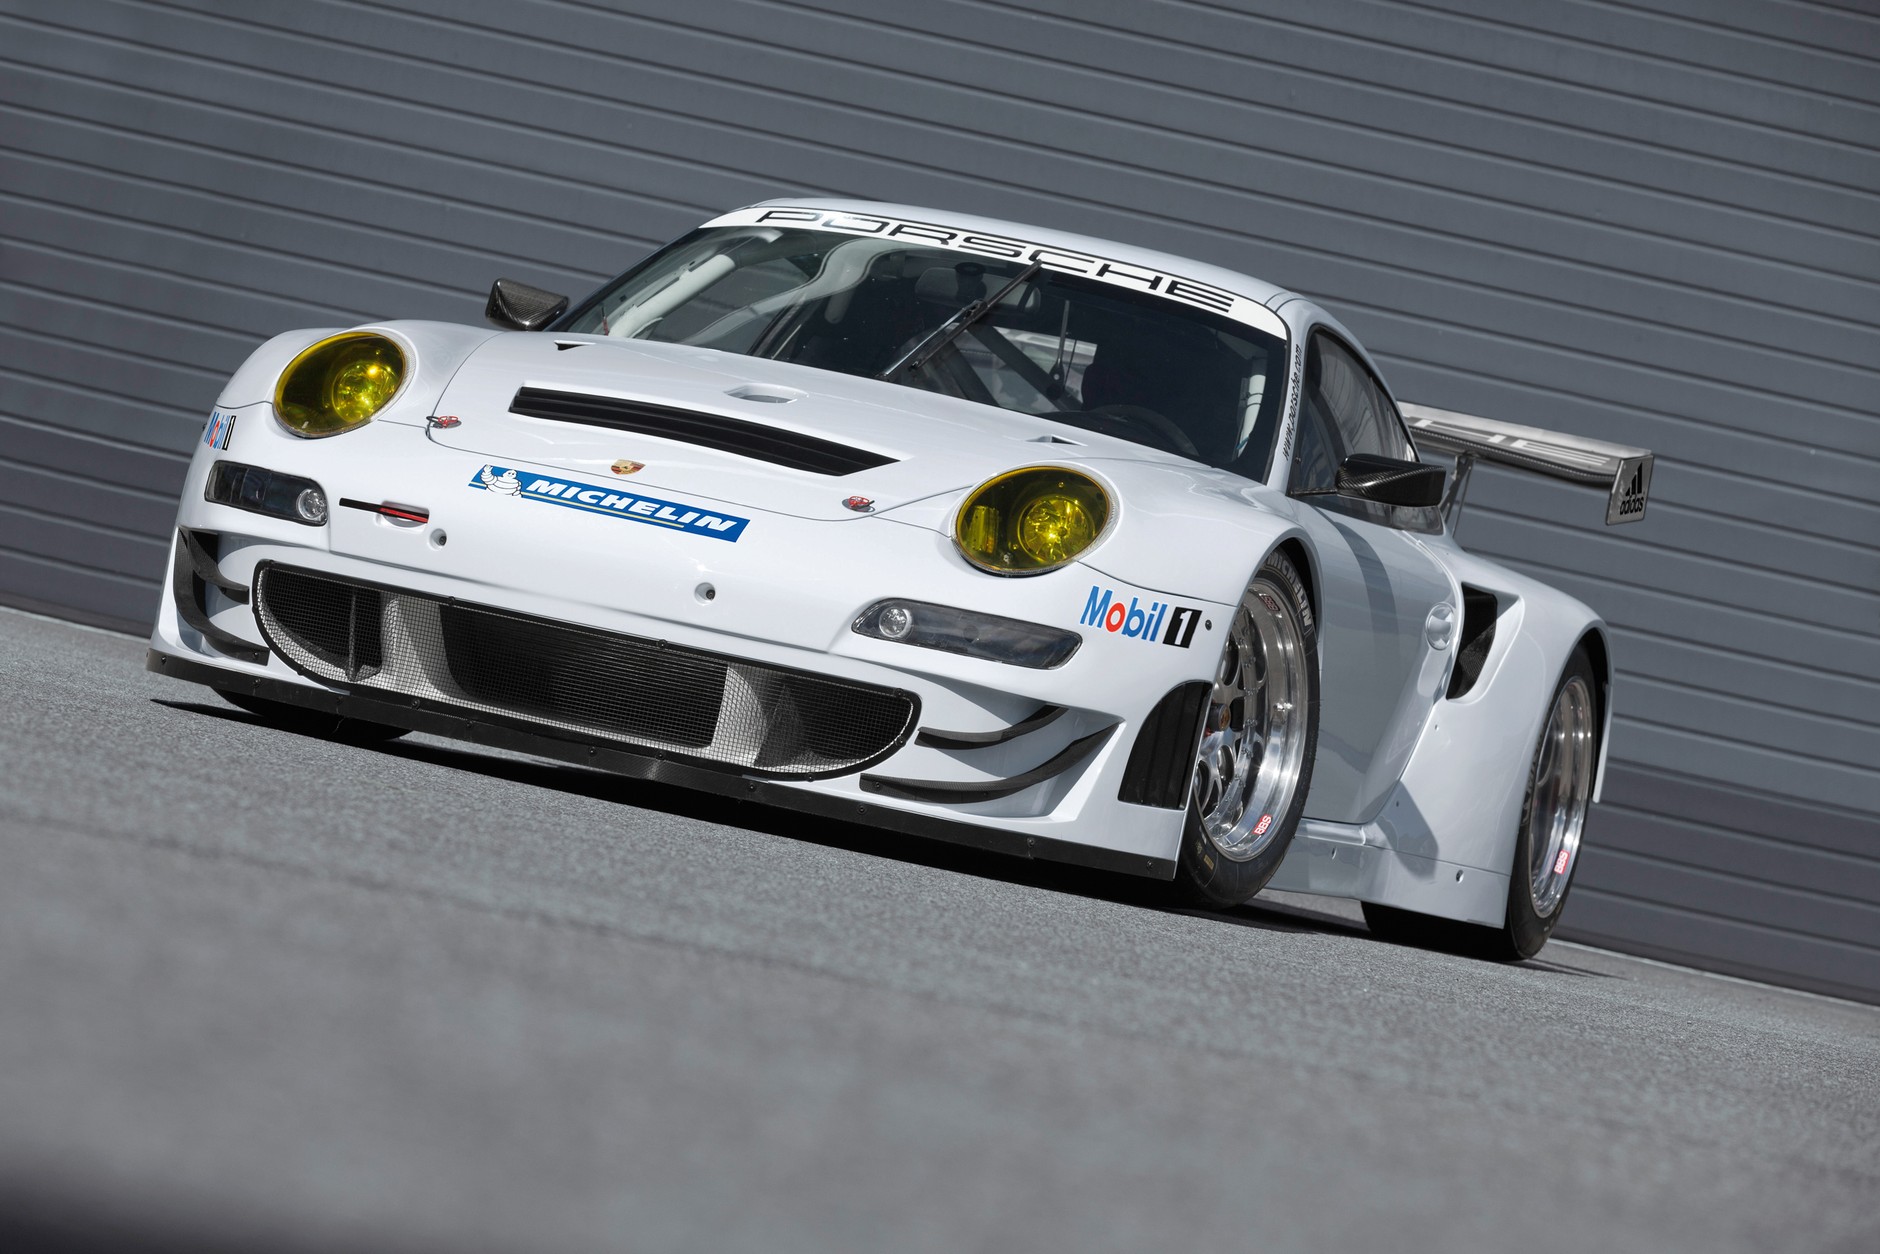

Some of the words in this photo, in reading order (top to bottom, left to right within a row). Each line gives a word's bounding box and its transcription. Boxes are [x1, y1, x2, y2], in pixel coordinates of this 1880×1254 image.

[756, 210, 1235, 313] PORSCHE
[1283, 344, 1302, 461] www.porsche.com
[527, 479, 738, 532] MICHELIN
[1620, 495, 1644, 515] adidas
[1079, 585, 1168, 642] Mobil
[1171, 609, 1195, 647] 1
[1266, 550, 1312, 627] MICHELIN
[1253, 815, 1272, 835] BBS
[1554, 850, 1568, 874] BBS
